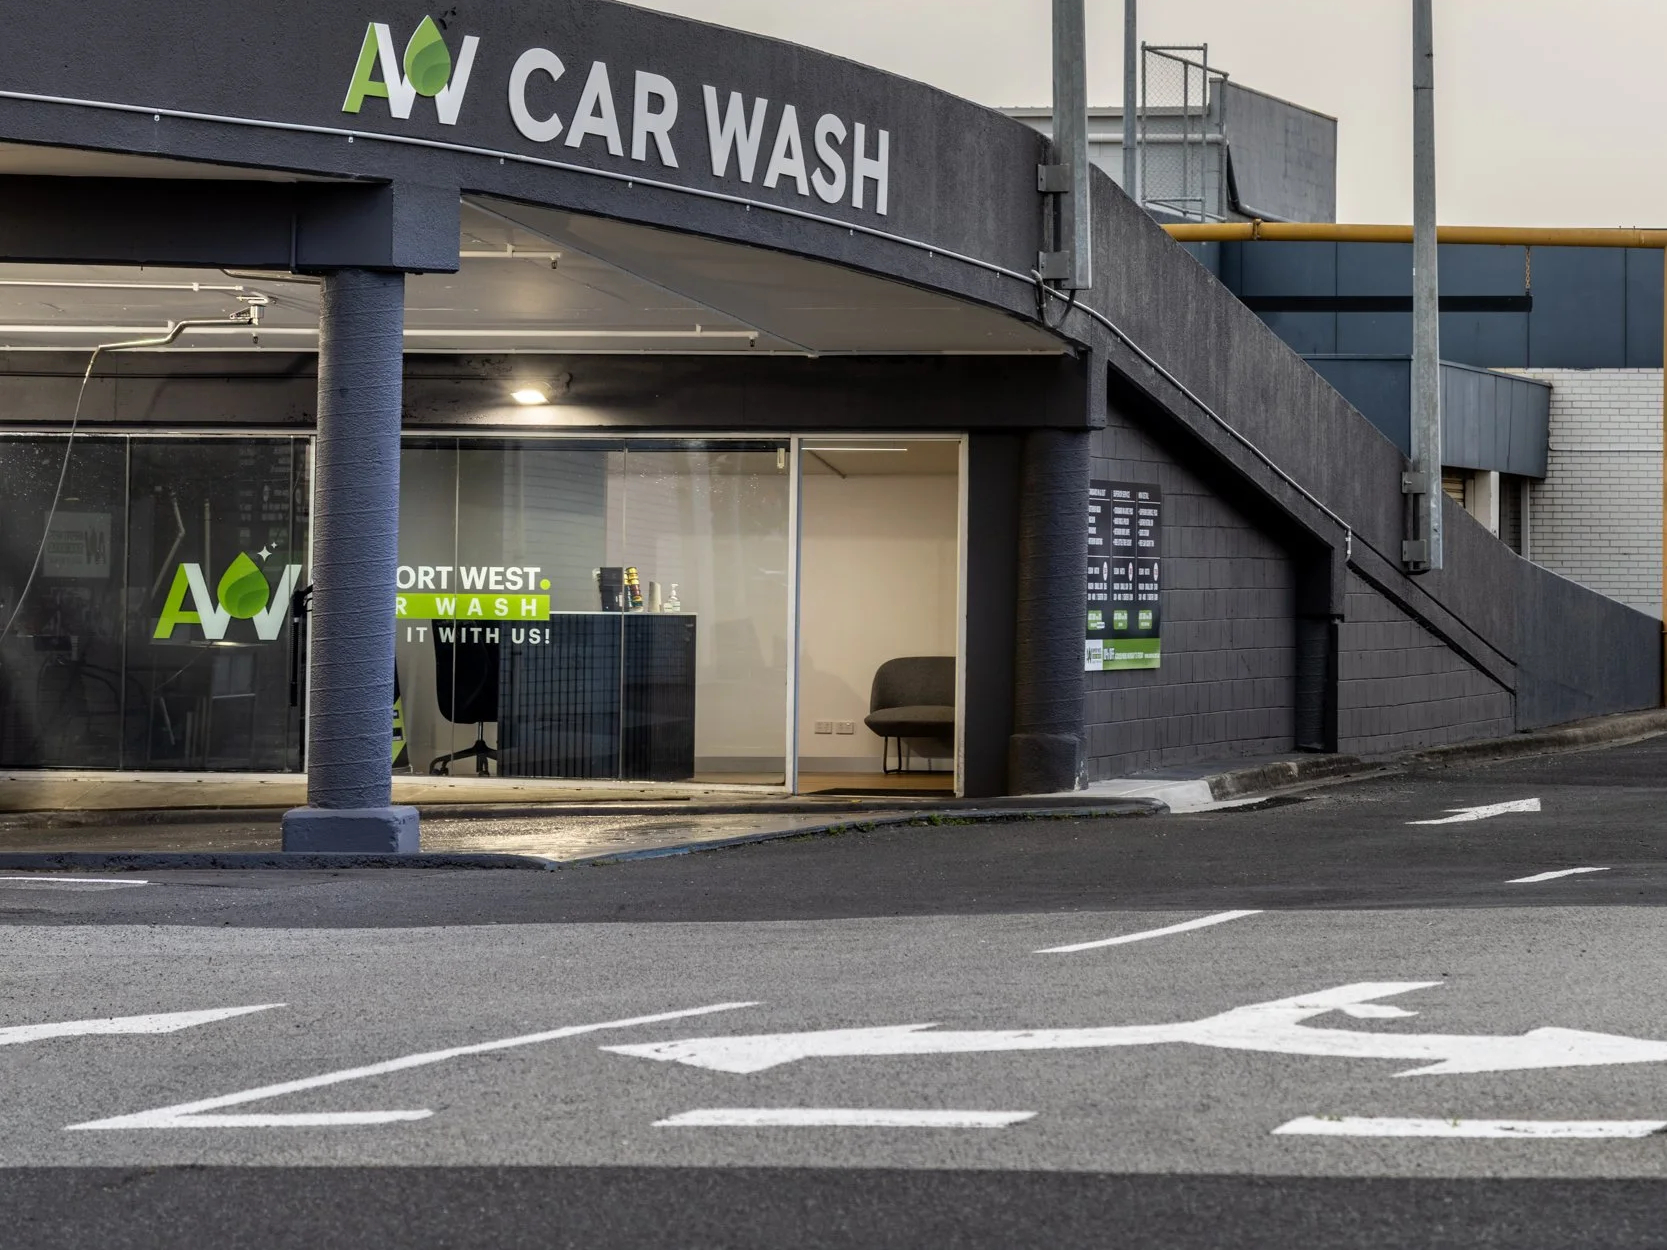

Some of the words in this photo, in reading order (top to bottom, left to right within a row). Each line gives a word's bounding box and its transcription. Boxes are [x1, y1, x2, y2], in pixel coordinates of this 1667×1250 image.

[342, 20, 480, 125] AW
[508, 48, 678, 168] CAR
[703, 84, 889, 216] WASH
[153, 562, 302, 641] AW
[436, 597, 537, 617] WASH
[406, 627, 428, 643] IT
[439, 627, 501, 644] WITH
[511, 628, 551, 644] US!
